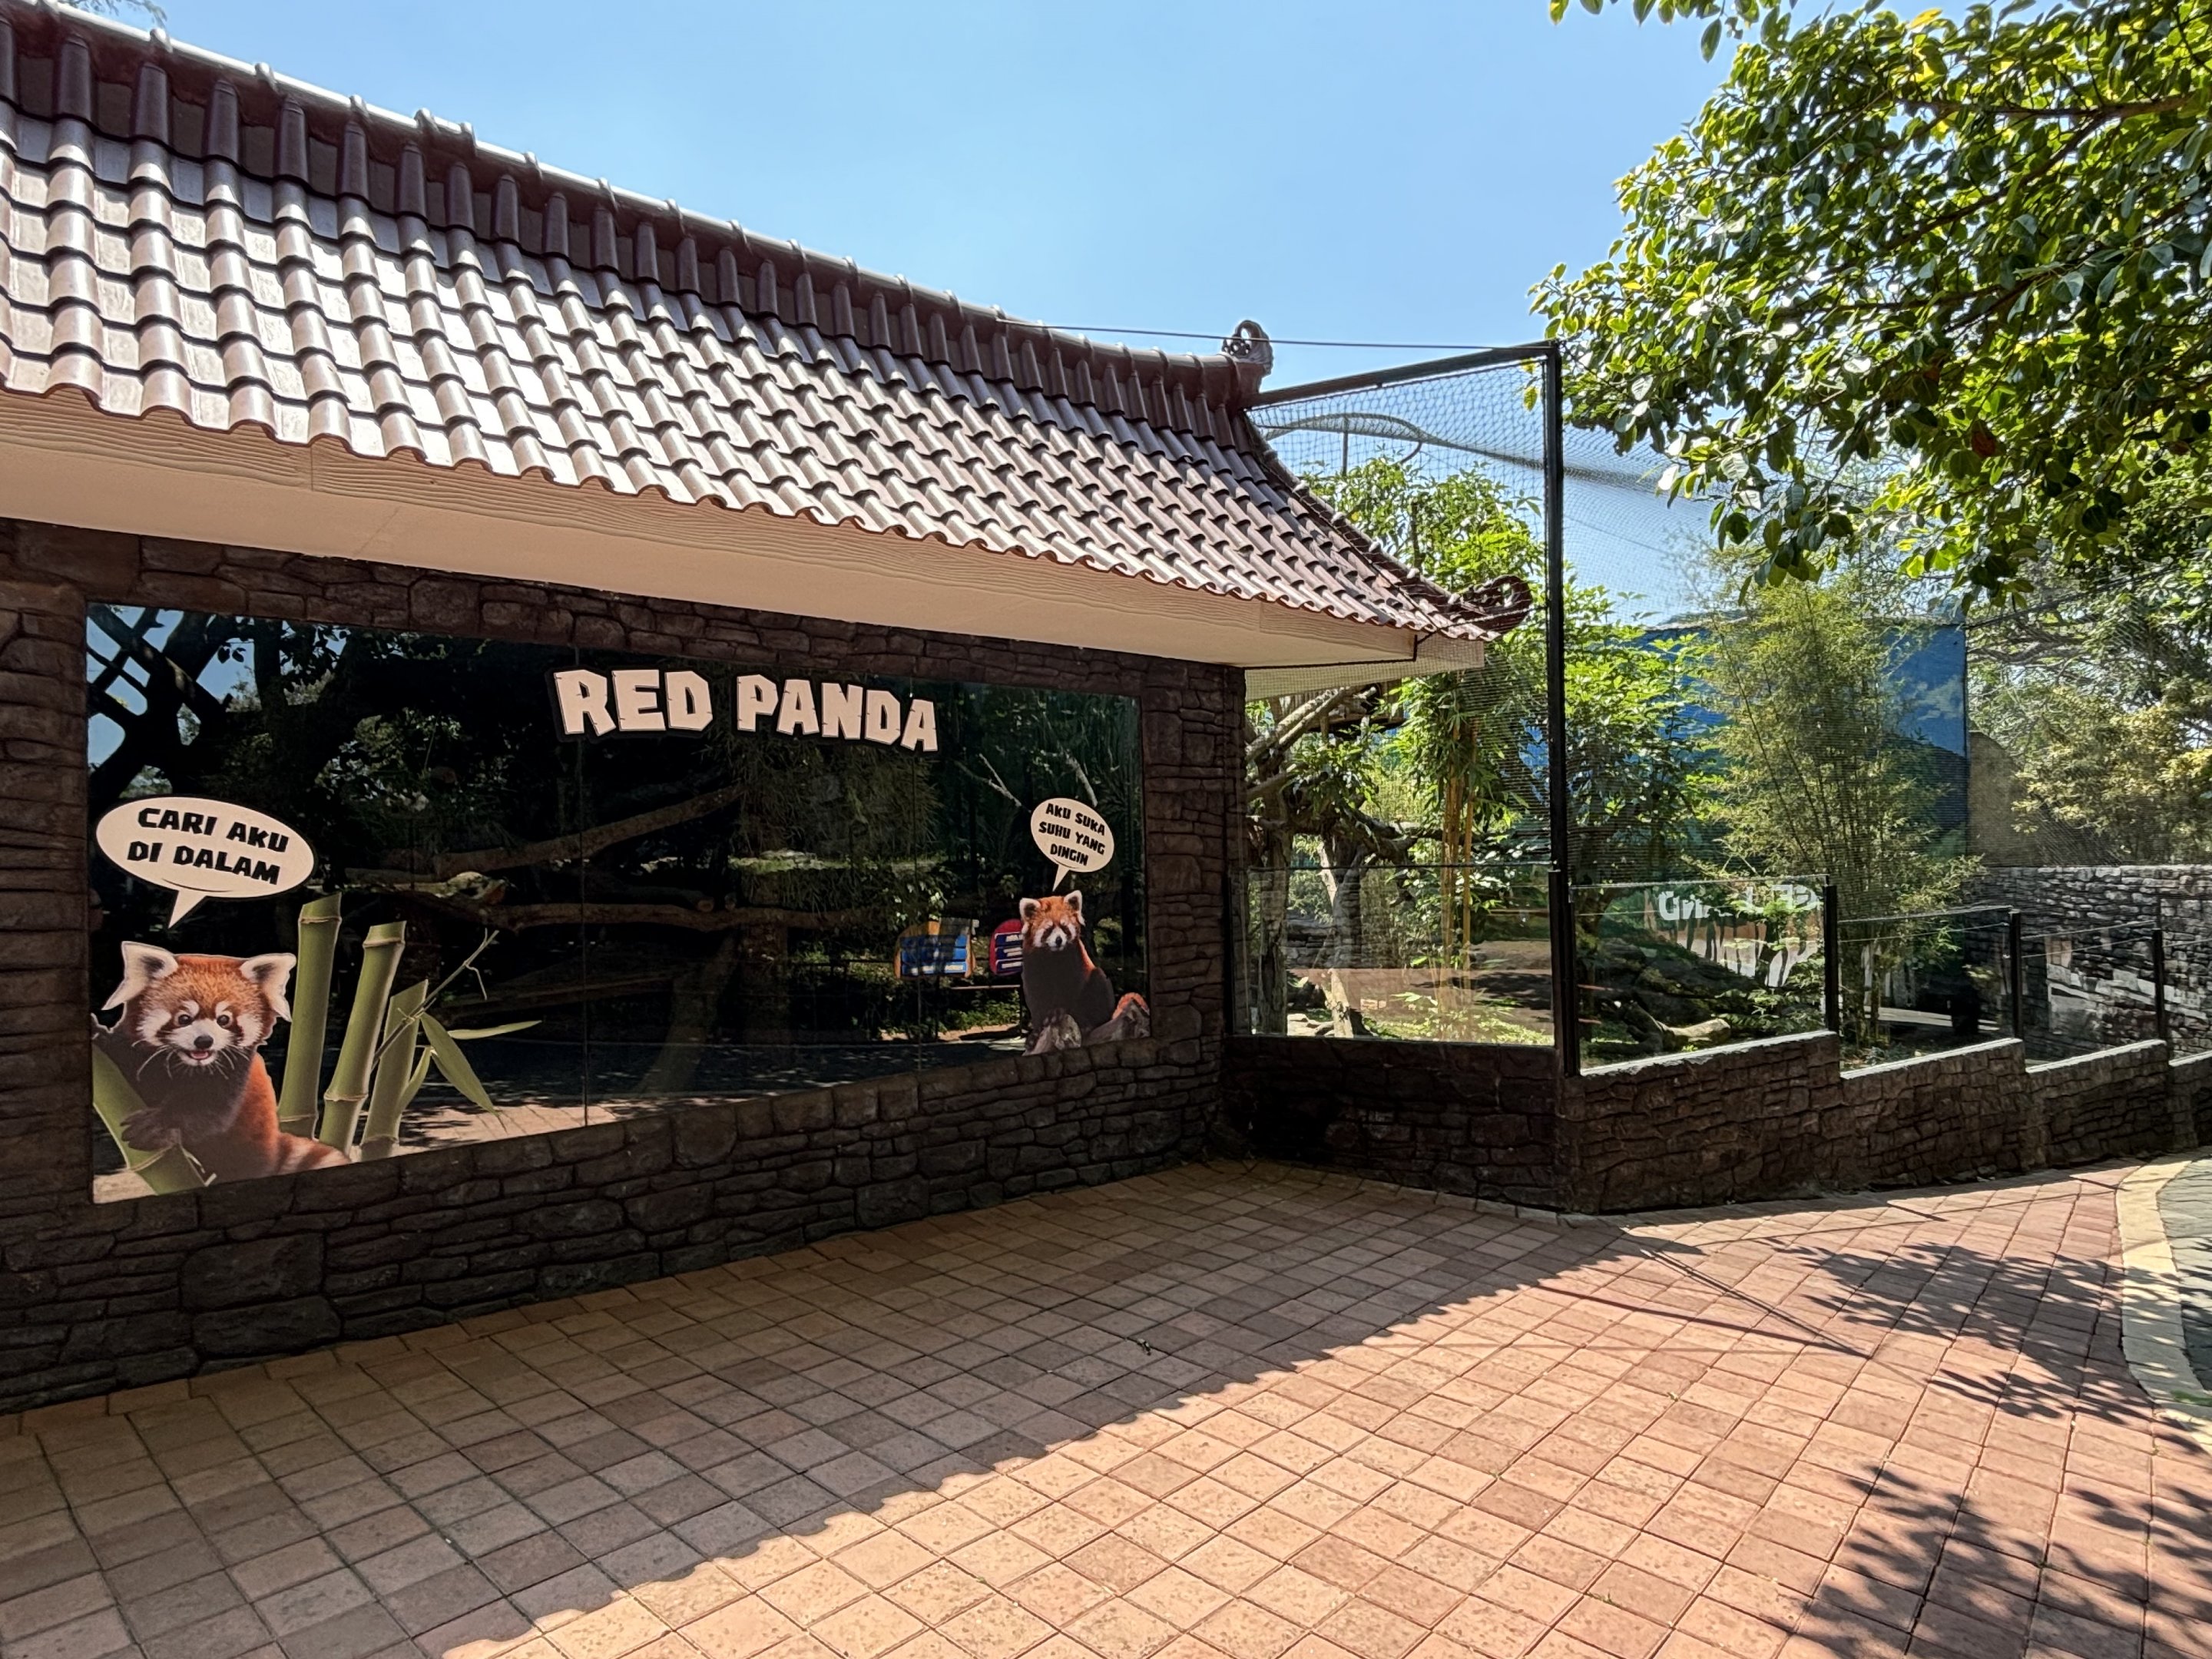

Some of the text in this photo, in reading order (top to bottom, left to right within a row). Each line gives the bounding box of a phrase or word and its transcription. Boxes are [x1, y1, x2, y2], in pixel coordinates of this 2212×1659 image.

[554, 669, 939, 752] RED PANDA
[137, 807, 290, 853] CARI AKU
[1038, 821, 1106, 856] SUHU YANG
[1045, 803, 1105, 836] AKU SUKA
[127, 840, 281, 885] DI DALAM
[1050, 843, 1089, 866] DINGIN
